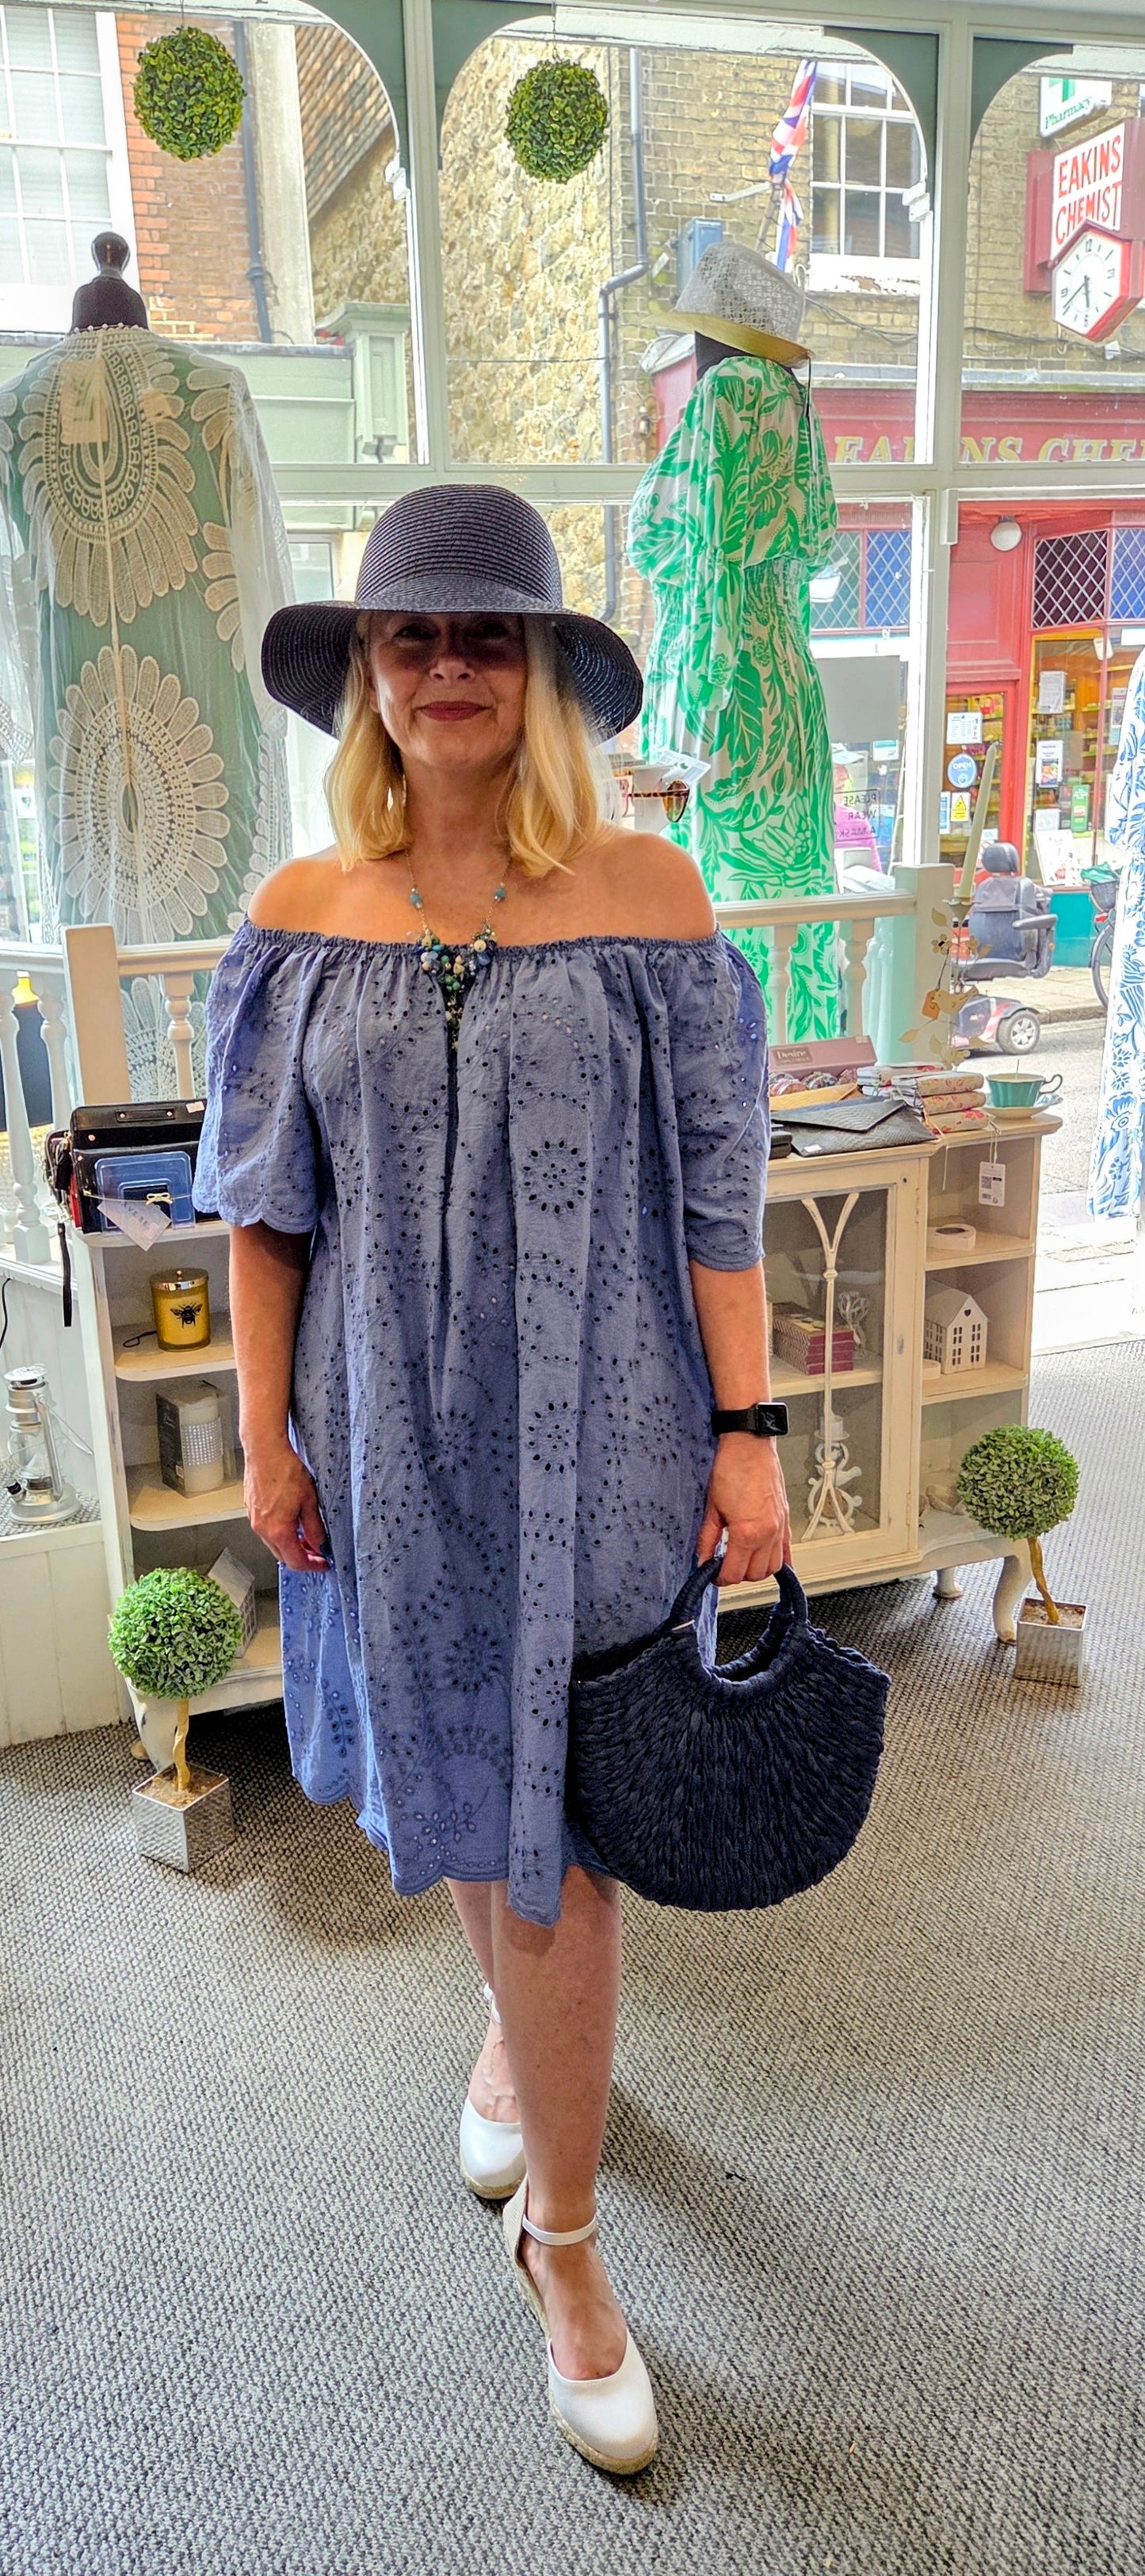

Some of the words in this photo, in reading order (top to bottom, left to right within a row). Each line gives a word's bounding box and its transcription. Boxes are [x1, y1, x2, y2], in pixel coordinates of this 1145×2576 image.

[1044, 96, 1092, 129] Pharmacy
[1058, 135, 1121, 198] EAKINS
[1055, 180, 1123, 246] CHEMIST
[1085, 238, 1093, 253] 12
[1038, 438, 1145, 463] CHE
[952, 761, 971, 770] OPEN
